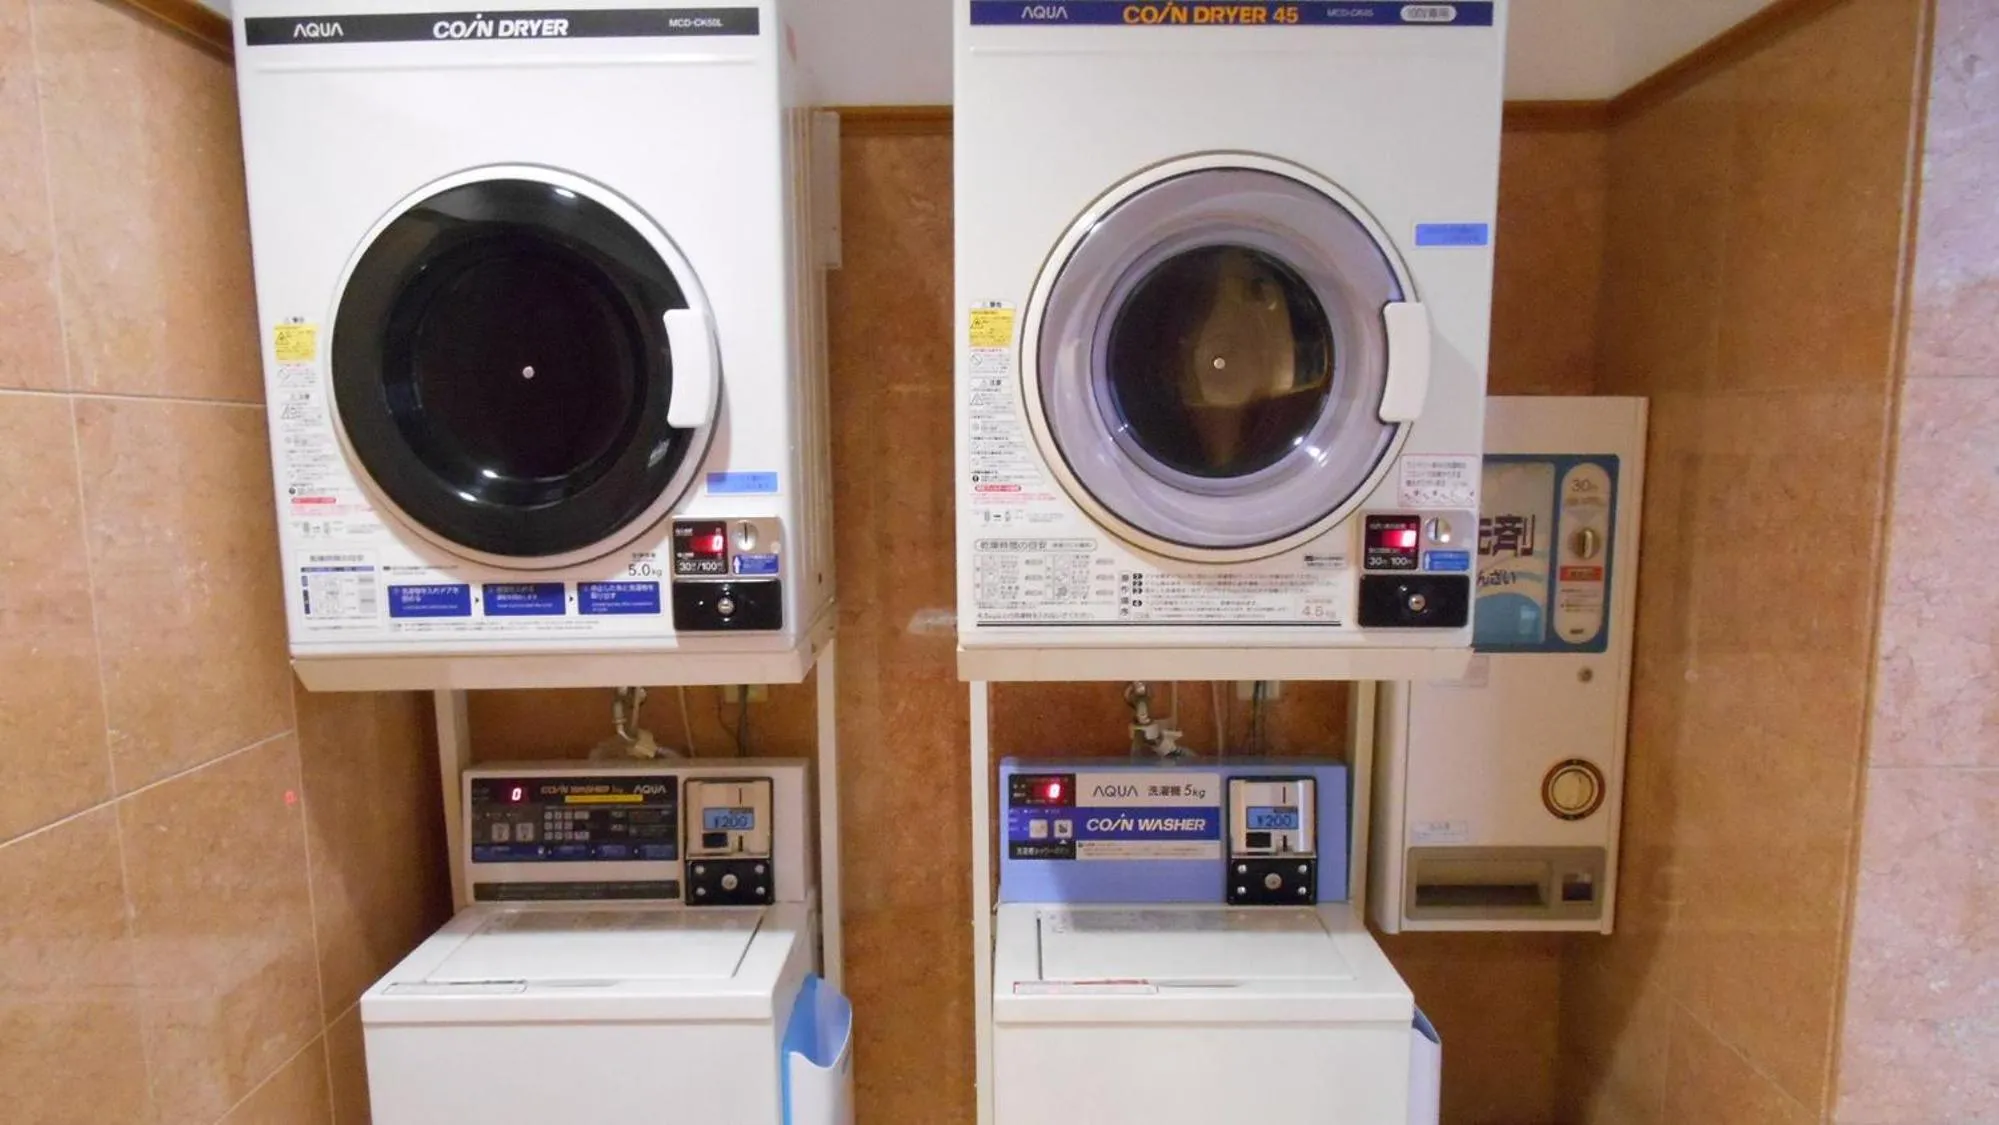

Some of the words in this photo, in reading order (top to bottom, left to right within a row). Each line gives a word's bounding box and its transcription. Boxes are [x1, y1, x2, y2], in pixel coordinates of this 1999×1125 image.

[1021, 6, 1068, 19] AQUA
[1194, 6, 1267, 24] DRYER
[1273, 7, 1299, 24] 45
[293, 22, 344, 38] AQUA
[498, 19, 569, 37] DRYER
[511, 787, 522, 801] 0
[633, 784, 667, 795] AQUA
[1093, 785, 1138, 798] AQUA
[1184, 784, 1206, 799] 5kg
[1138, 819, 1206, 831] WASHER
